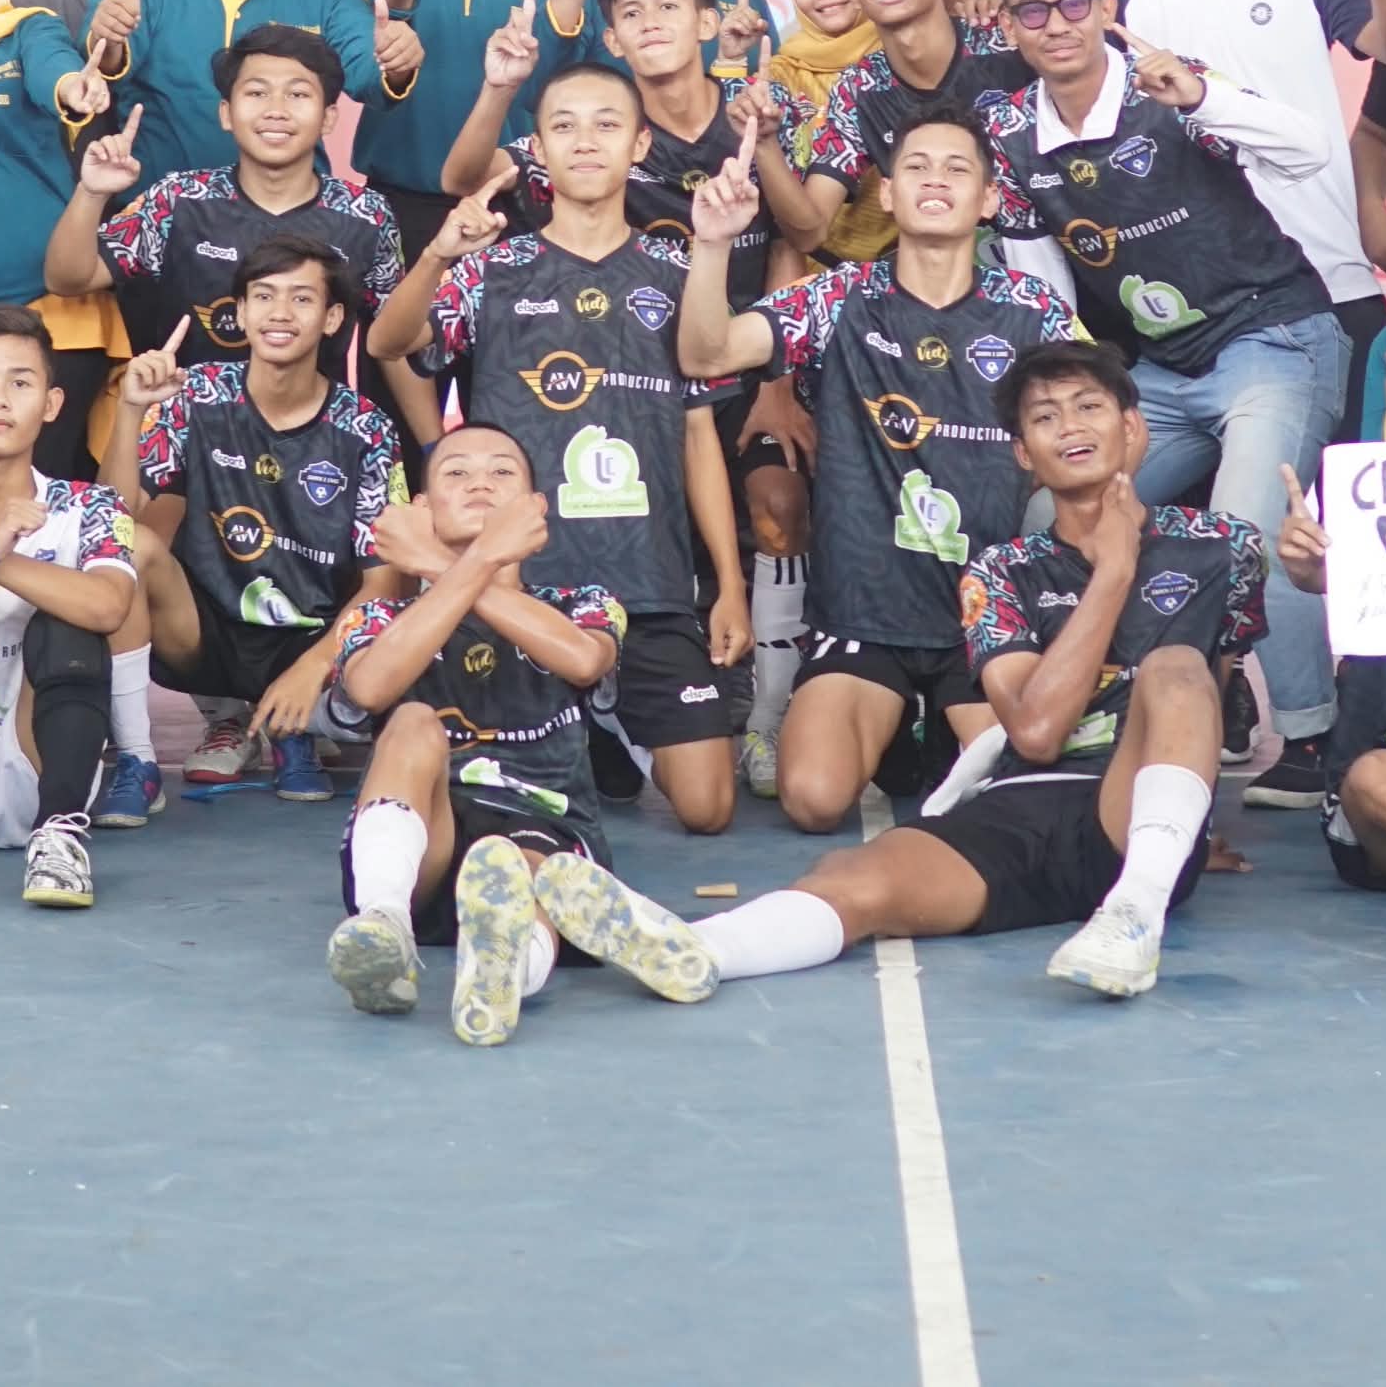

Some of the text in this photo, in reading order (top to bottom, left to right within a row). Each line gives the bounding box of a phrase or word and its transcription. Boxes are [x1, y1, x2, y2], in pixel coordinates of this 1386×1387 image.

[1117, 207, 1190, 242] PRODUCTION
[197, 241, 238, 261] elsport
[514, 299, 560, 315] elsport
[602, 372, 672, 394] PRODUCTION
[934, 422, 1012, 442] PRODUCTION
